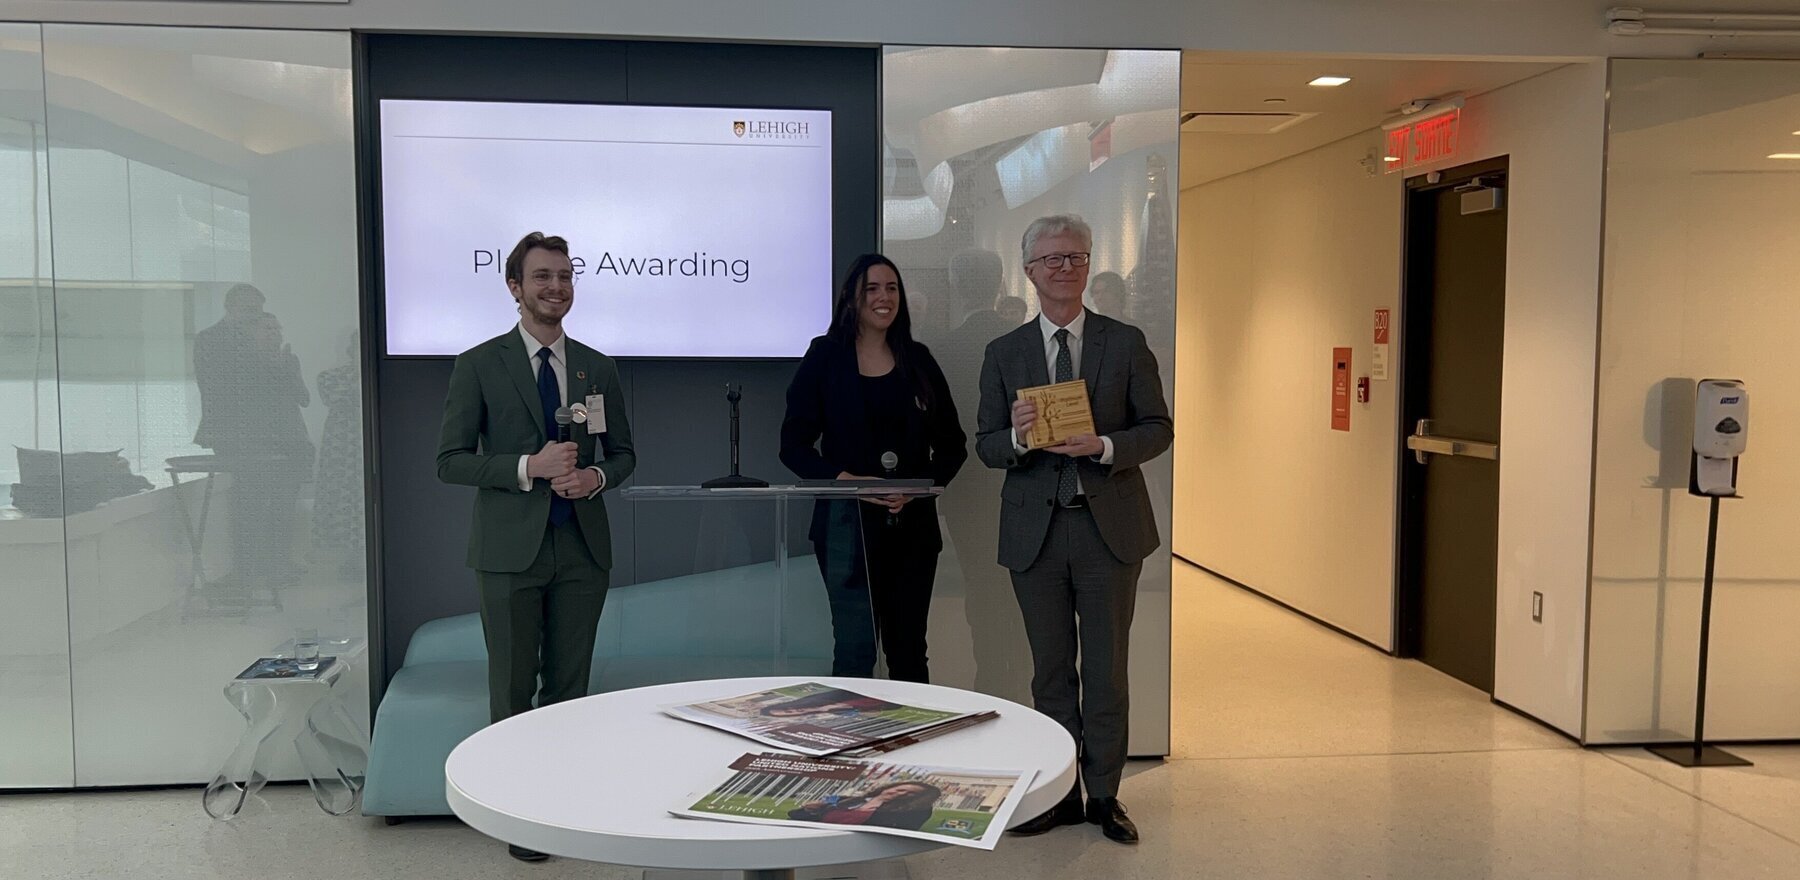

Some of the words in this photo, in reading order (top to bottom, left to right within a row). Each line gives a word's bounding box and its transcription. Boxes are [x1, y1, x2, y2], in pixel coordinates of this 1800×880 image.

[748, 121, 809, 134] LEHIGH
[474, 249, 586, 275] Ple
[596, 252, 749, 283] Awarding
[720, 805, 775, 815] LEHIGH
